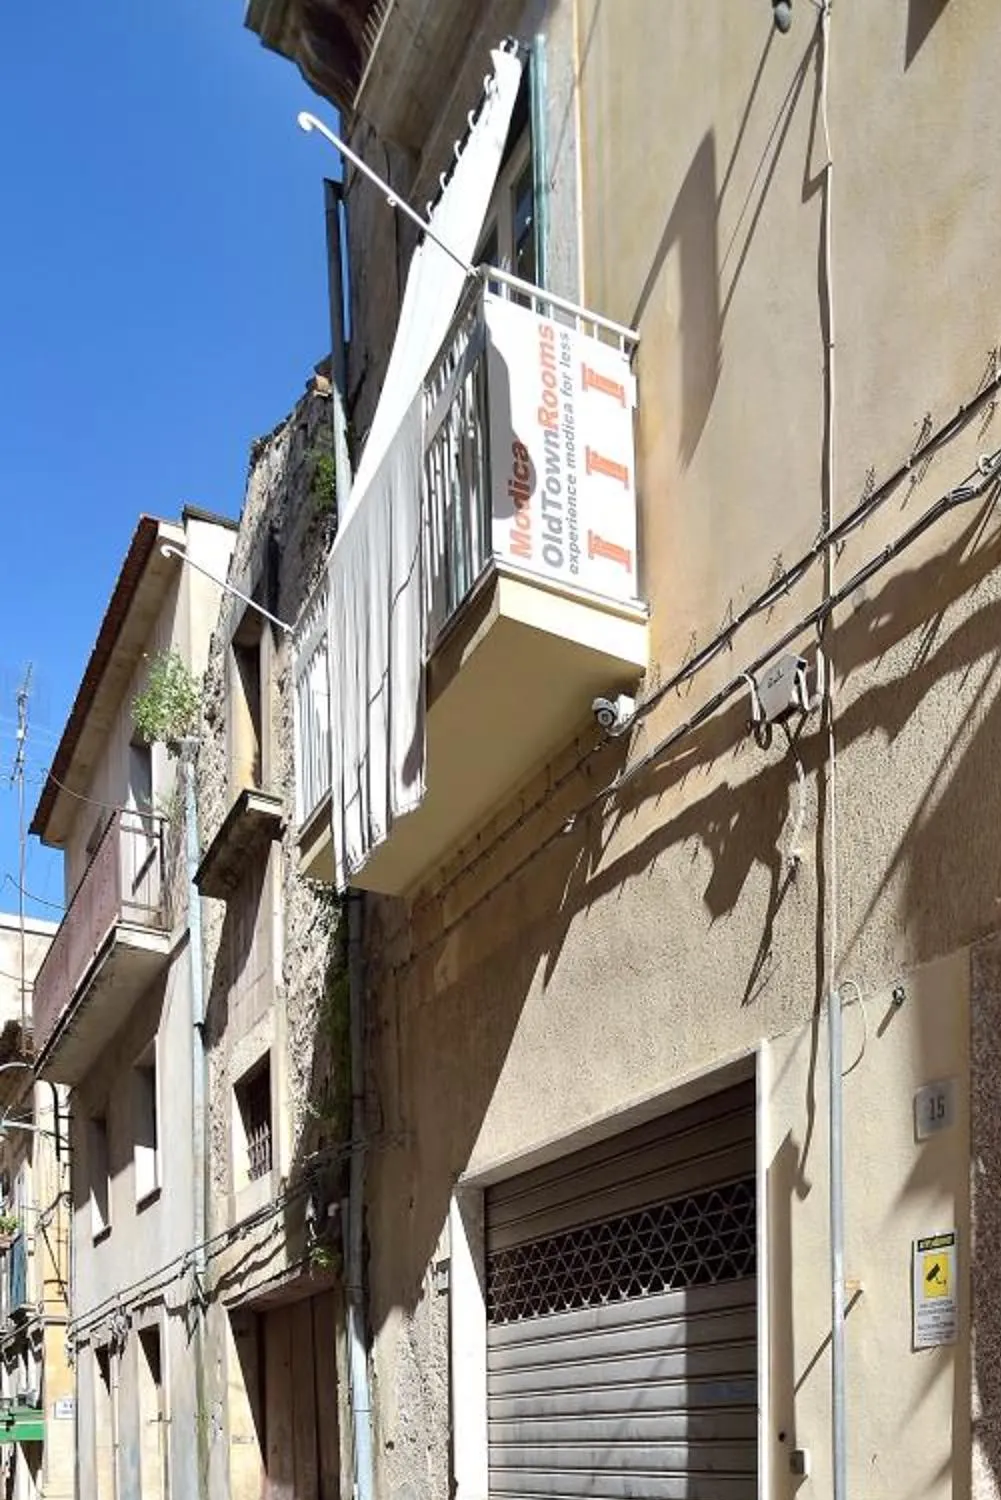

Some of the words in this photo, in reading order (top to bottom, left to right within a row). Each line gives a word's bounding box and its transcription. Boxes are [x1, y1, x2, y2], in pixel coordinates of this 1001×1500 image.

[561, 332, 571, 369] less
[561, 373, 573, 398] for
[538, 324, 564, 569] OldTownRooms
[563, 404, 577, 469] modica
[508, 440, 533, 560] Modica
[568, 473, 580, 576] experience
[929, 1094, 945, 1120] 15
